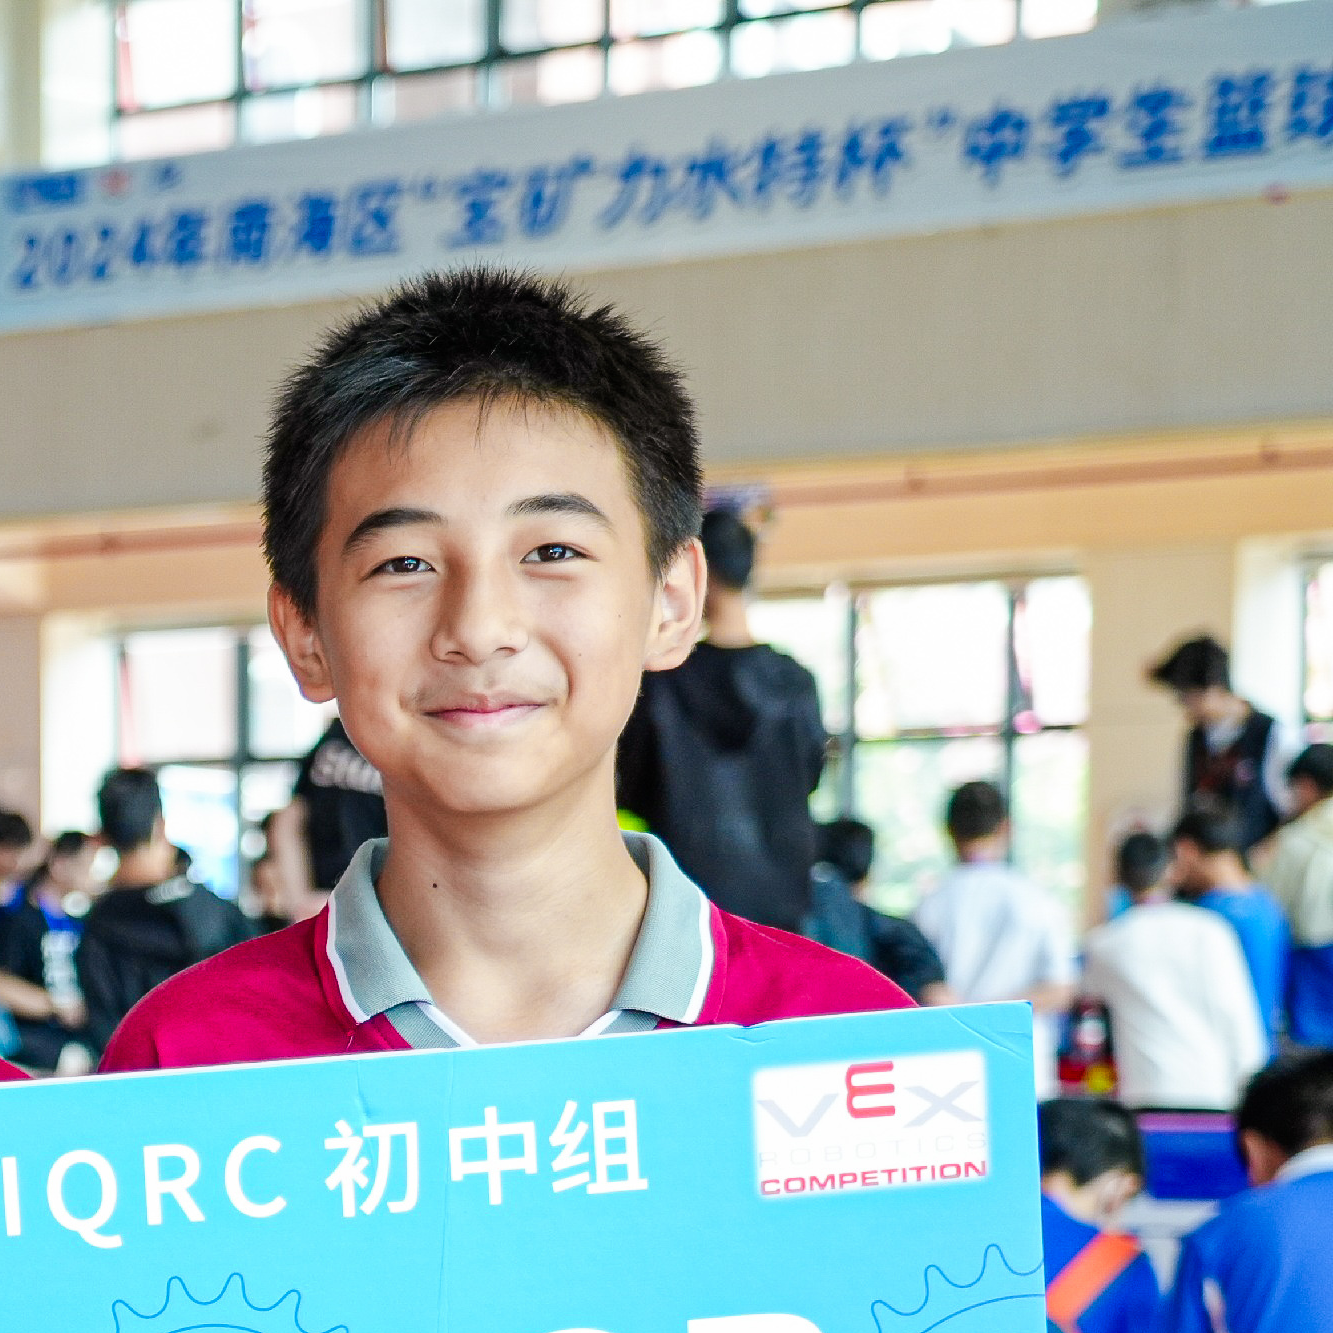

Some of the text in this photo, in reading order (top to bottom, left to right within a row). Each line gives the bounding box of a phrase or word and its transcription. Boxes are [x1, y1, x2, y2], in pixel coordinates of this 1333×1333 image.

[756, 1060, 985, 1138] VEX
[322, 1097, 649, 1219] 初中组
[760, 1160, 987, 1196] COMPETITION
